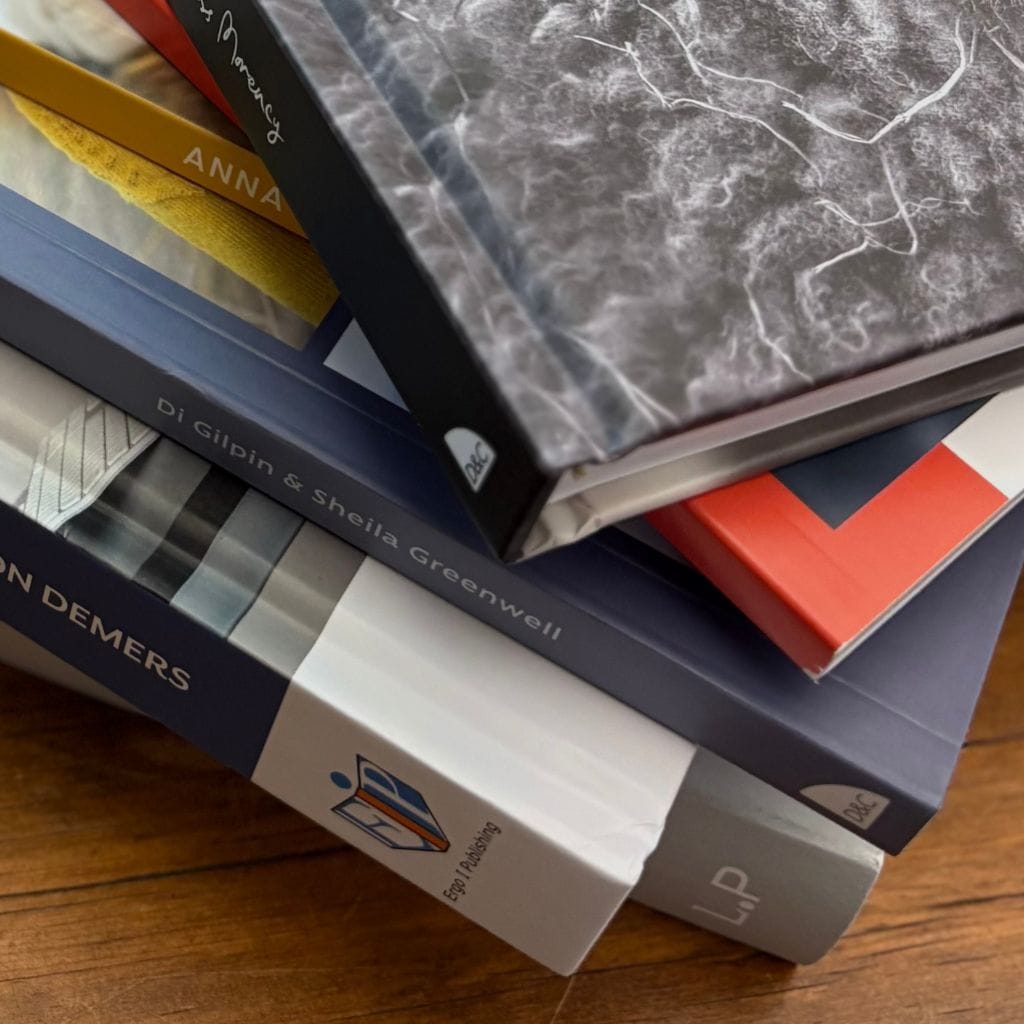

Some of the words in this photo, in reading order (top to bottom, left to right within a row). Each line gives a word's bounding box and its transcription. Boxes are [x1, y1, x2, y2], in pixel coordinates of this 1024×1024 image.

[216, 9, 285, 144] Morency
[183, 146, 282, 212] ANNA
[156, 395, 185, 425] Di
[193, 419, 274, 476] Gilpin
[282, 473, 303, 492] &
[311, 488, 399, 549] Sheila
[409, 545, 564, 642] Greenwell
[42, 584, 192, 692] DEMERS
[843, 793, 877, 823] D&C
[443, 877, 466, 902] Ergo
[465, 820, 502, 873] Publishing
